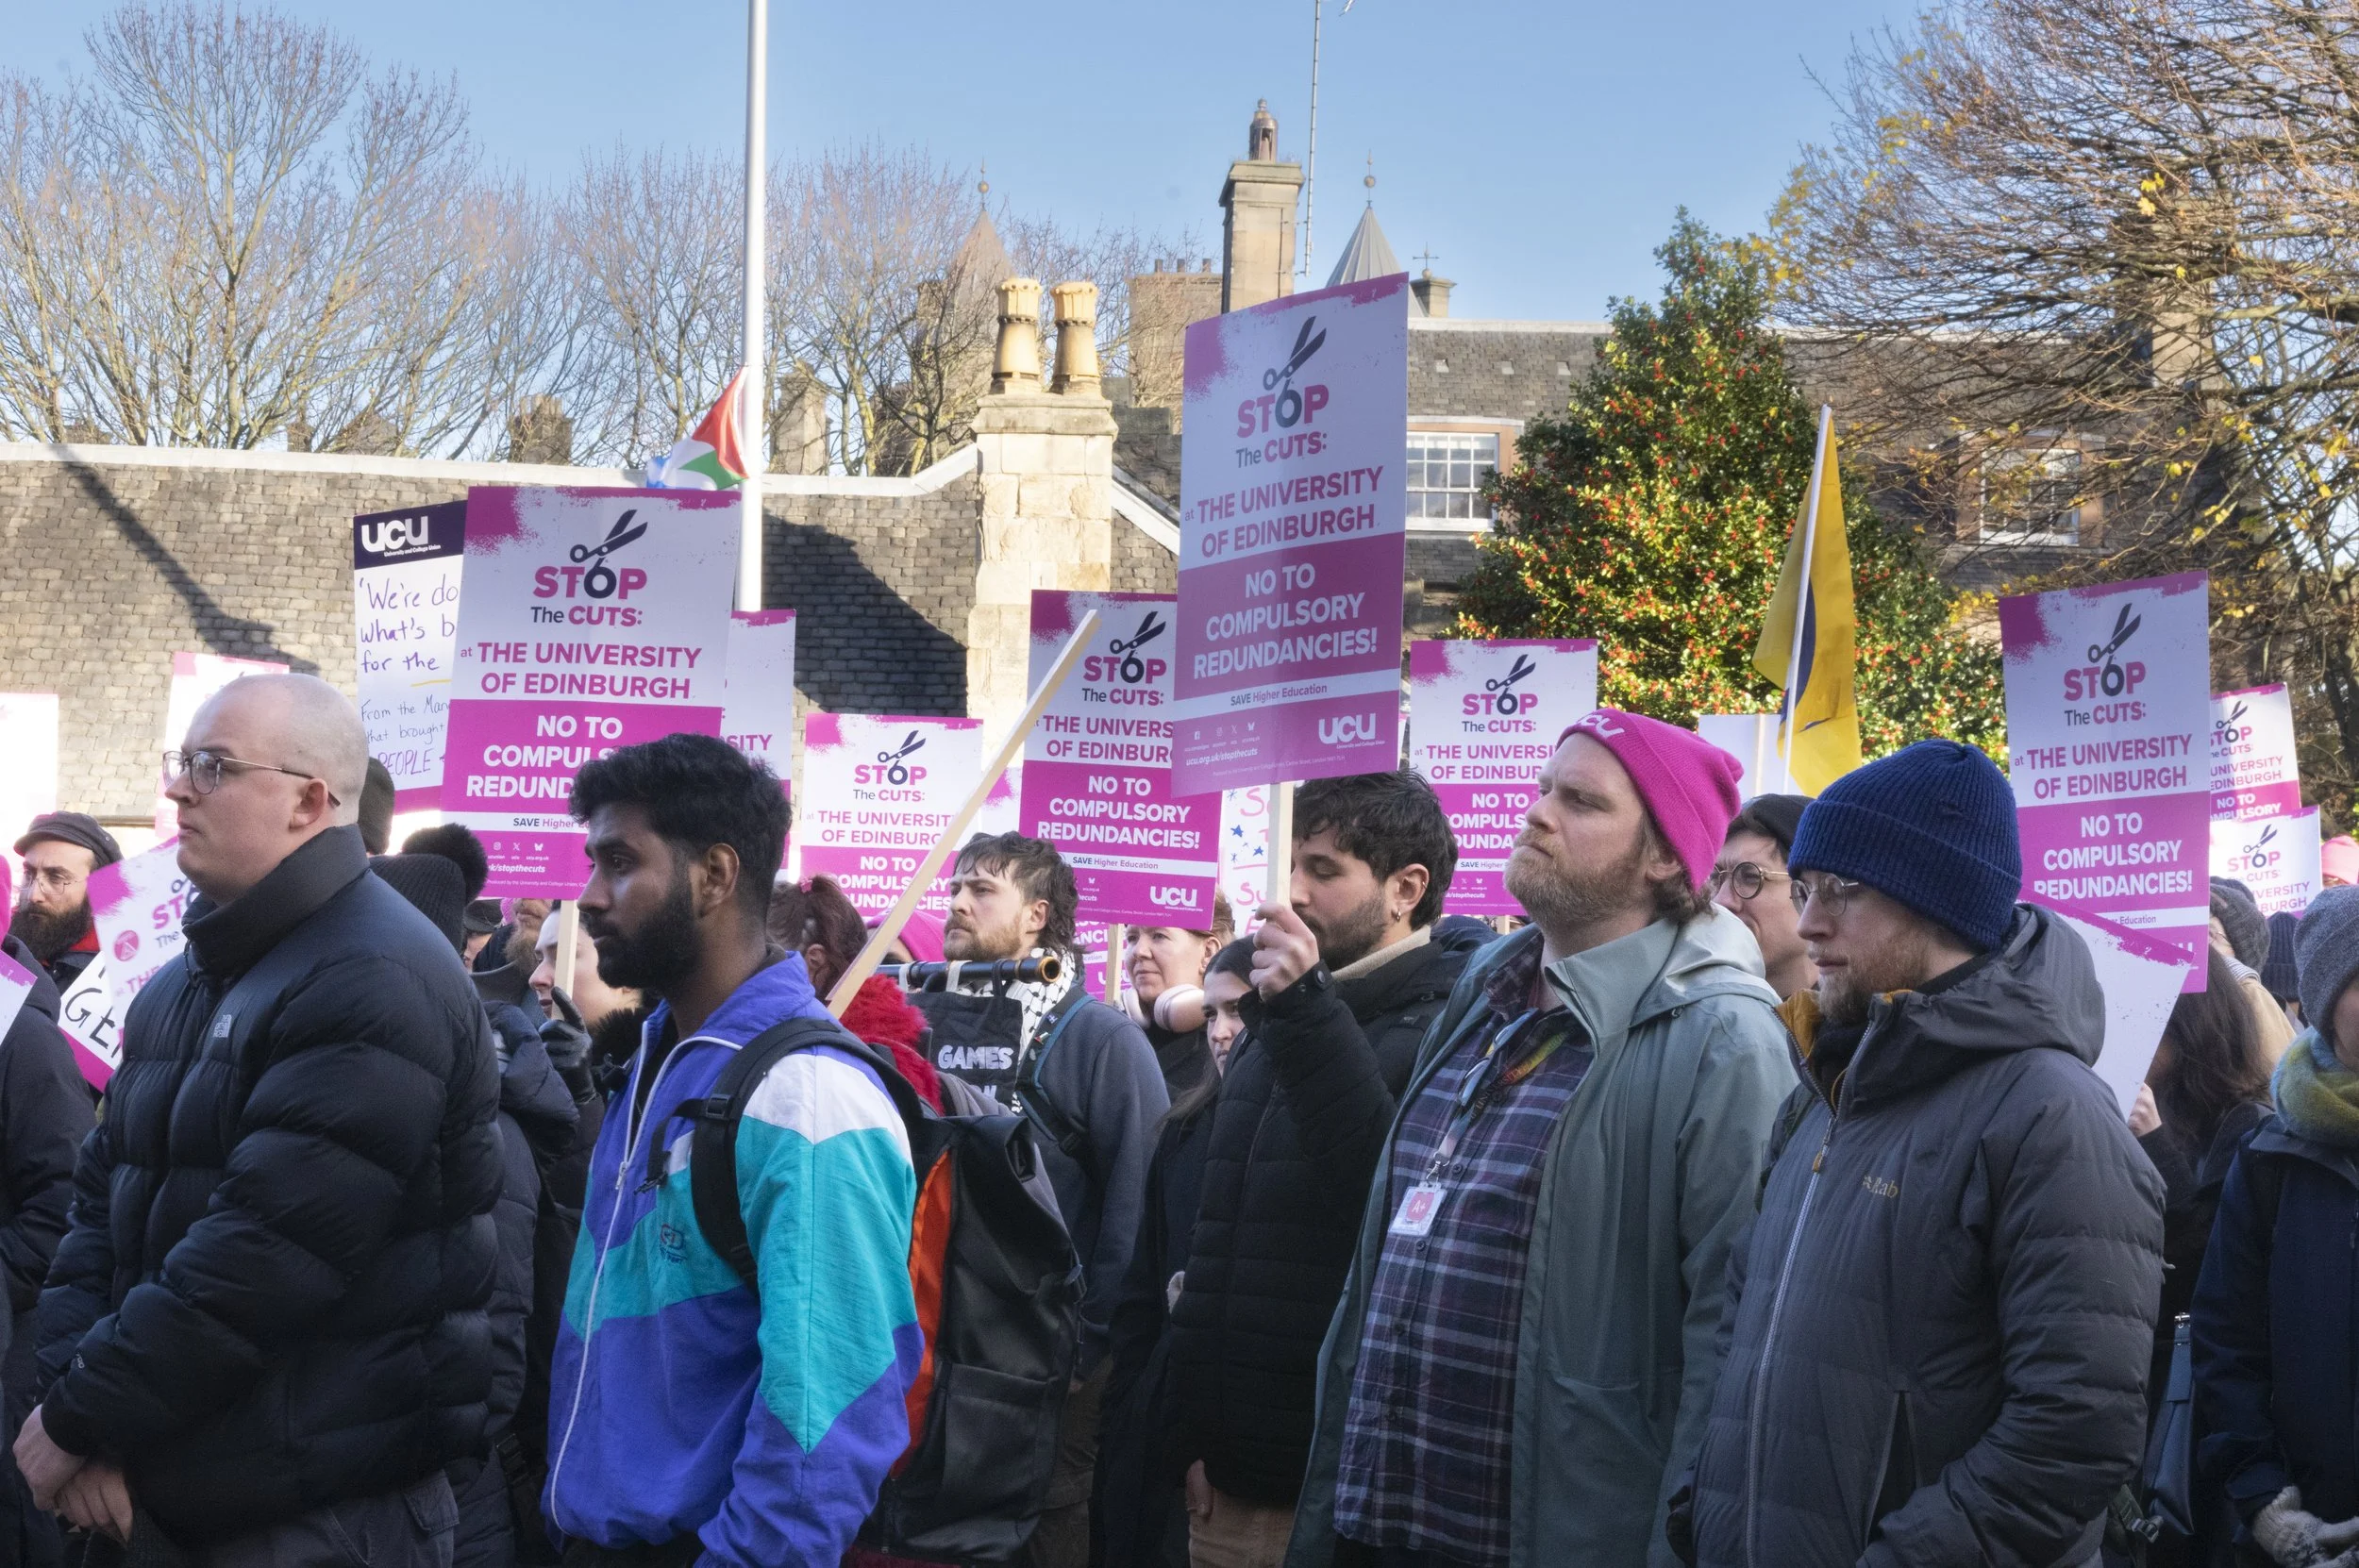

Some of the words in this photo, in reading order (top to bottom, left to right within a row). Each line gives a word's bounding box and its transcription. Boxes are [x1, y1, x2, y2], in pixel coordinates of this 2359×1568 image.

[1237, 384, 1329, 438] STOP
[1236, 447, 1262, 468] The
[1264, 431, 1327, 462] CUTS:
[1185, 509, 1194, 521] at
[1197, 493, 1235, 524] THE
[1241, 465, 1383, 514] UNIVERSITY
[1202, 529, 1229, 558] OF
[1234, 504, 1375, 551] EDINBURGH
[533, 565, 647, 599] STOP
[1246, 570, 1276, 598] NO
[1282, 563, 1315, 591] TO
[530, 607, 564, 624] The
[568, 606, 644, 627] CUTS:
[1206, 592, 1365, 642] COMPULSORY
[360, 649, 393, 673] for
[402, 651, 440, 671] the
[460, 647, 472, 658] at
[477, 642, 527, 662] THE
[535, 642, 702, 669] UNIVERSITY
[1194, 627, 1378, 679] REDUNDANCIES!
[1083, 656, 1166, 684] STOP
[2064, 661, 2146, 701] STOP
[481, 673, 516, 693] OF
[525, 673, 690, 699] EDINBURGH
[1082, 688, 1107, 702] The
[1109, 689, 1164, 706] CUTS:
[1230, 695, 1251, 707] SAVE
[1252, 690, 1280, 703] Higher
[1282, 683, 1328, 698] Education
[361, 699, 392, 721] From
[397, 701, 415, 715] the
[1463, 693, 1538, 715] STOP
[2065, 709, 2090, 726] The
[2093, 701, 2146, 725] CUTS:
[399, 723, 444, 744] brought
[537, 715, 577, 738] NO
[584, 716, 624, 740] TO
[1043, 715, 1080, 733] THE
[1086, 717, 1175, 739] UNIVERS
[1462, 721, 1485, 732] The
[1488, 720, 1536, 733] CUTS:
[1046, 740, 1073, 757] OF
[1079, 741, 1172, 763] EDINBUR
[1427, 745, 1462, 759] THE
[1467, 745, 1560, 759] UNIVERSI
[2015, 756, 2024, 766] at
[2027, 747, 2066, 770] THE
[2072, 733, 2192, 766] UNIVERSITY
[854, 764, 927, 786] STOP
[1430, 765, 1456, 779] OF
[2210, 756, 2284, 776] UNIVERSITY
[466, 776, 575, 799] REDUND
[1088, 776, 1118, 794] NO
[1123, 777, 1151, 796] TO
[2034, 777, 2062, 799] OF
[2067, 765, 2186, 796] EDINBURGH
[853, 789, 876, 800] The
[878, 790, 925, 802] CUTS:
[1472, 792, 1499, 809] NO
[1504, 792, 1529, 809] TO
[2217, 797, 2235, 809] NO
[2237, 792, 2256, 806] TO
[818, 810, 851, 824] THE
[858, 811, 953, 827] UNIVERSIT
[1049, 798, 1191, 824] COMPULSORY
[2210, 802, 2282, 822] MPULSORY
[513, 818, 540, 826] SAVE
[543, 819, 575, 829] Higher
[1038, 821, 1201, 849] REDUNDANCIES!
[2081, 814, 2110, 838] NO
[2115, 812, 2143, 835] TO
[822, 830, 846, 842] OF
[861, 856, 888, 871] NO
[891, 857, 916, 872] TO
[1094, 859, 1117, 867] Higher
[1120, 859, 1159, 870] Education
[2044, 840, 2182, 871] COMPULSORY
[2227, 851, 2281, 872] STOP
[2261, 895, 2307, 913] BURGH
[2119, 915, 2157, 925] Education
[155, 930, 180, 949] The
[938, 1044, 1014, 1070] GAMES
